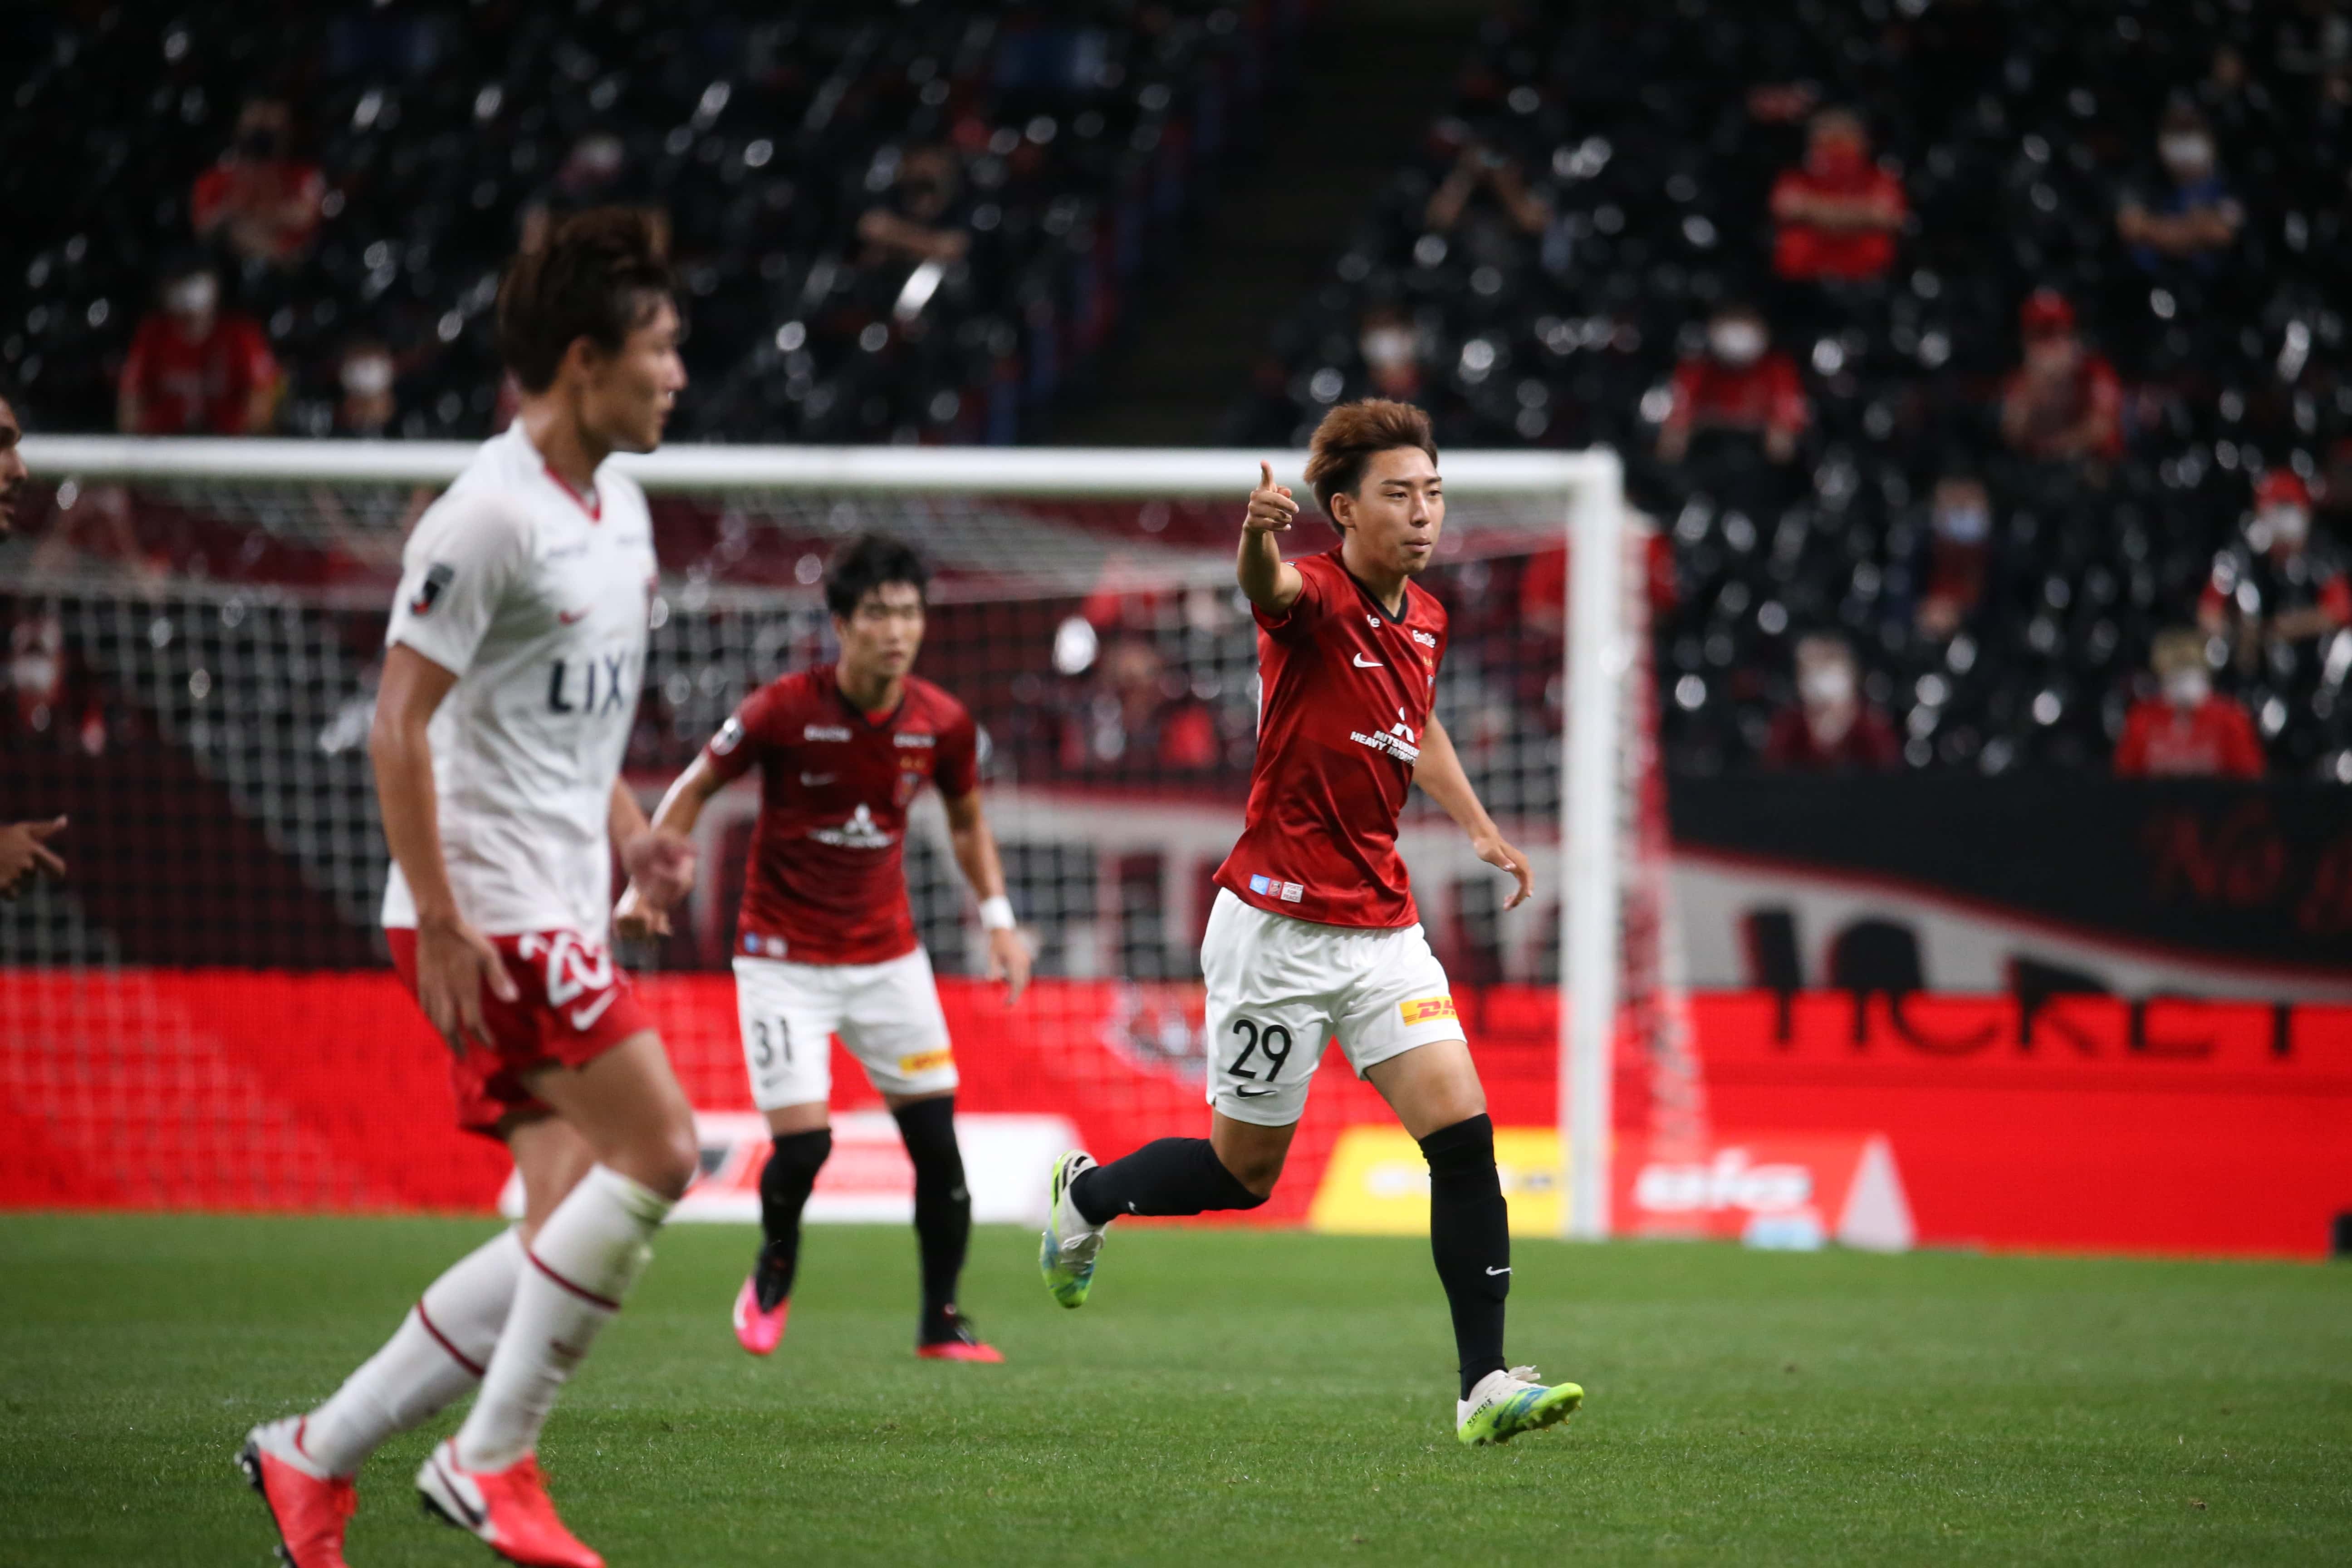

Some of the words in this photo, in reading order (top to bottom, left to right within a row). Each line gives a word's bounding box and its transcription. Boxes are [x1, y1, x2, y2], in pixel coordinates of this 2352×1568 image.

[1350, 731, 1387, 750] HEAVY
[752, 1016, 793, 1068] 31
[1227, 1019, 1292, 1083] 29
[1467, 1398, 1492, 1427] NEMESIS
